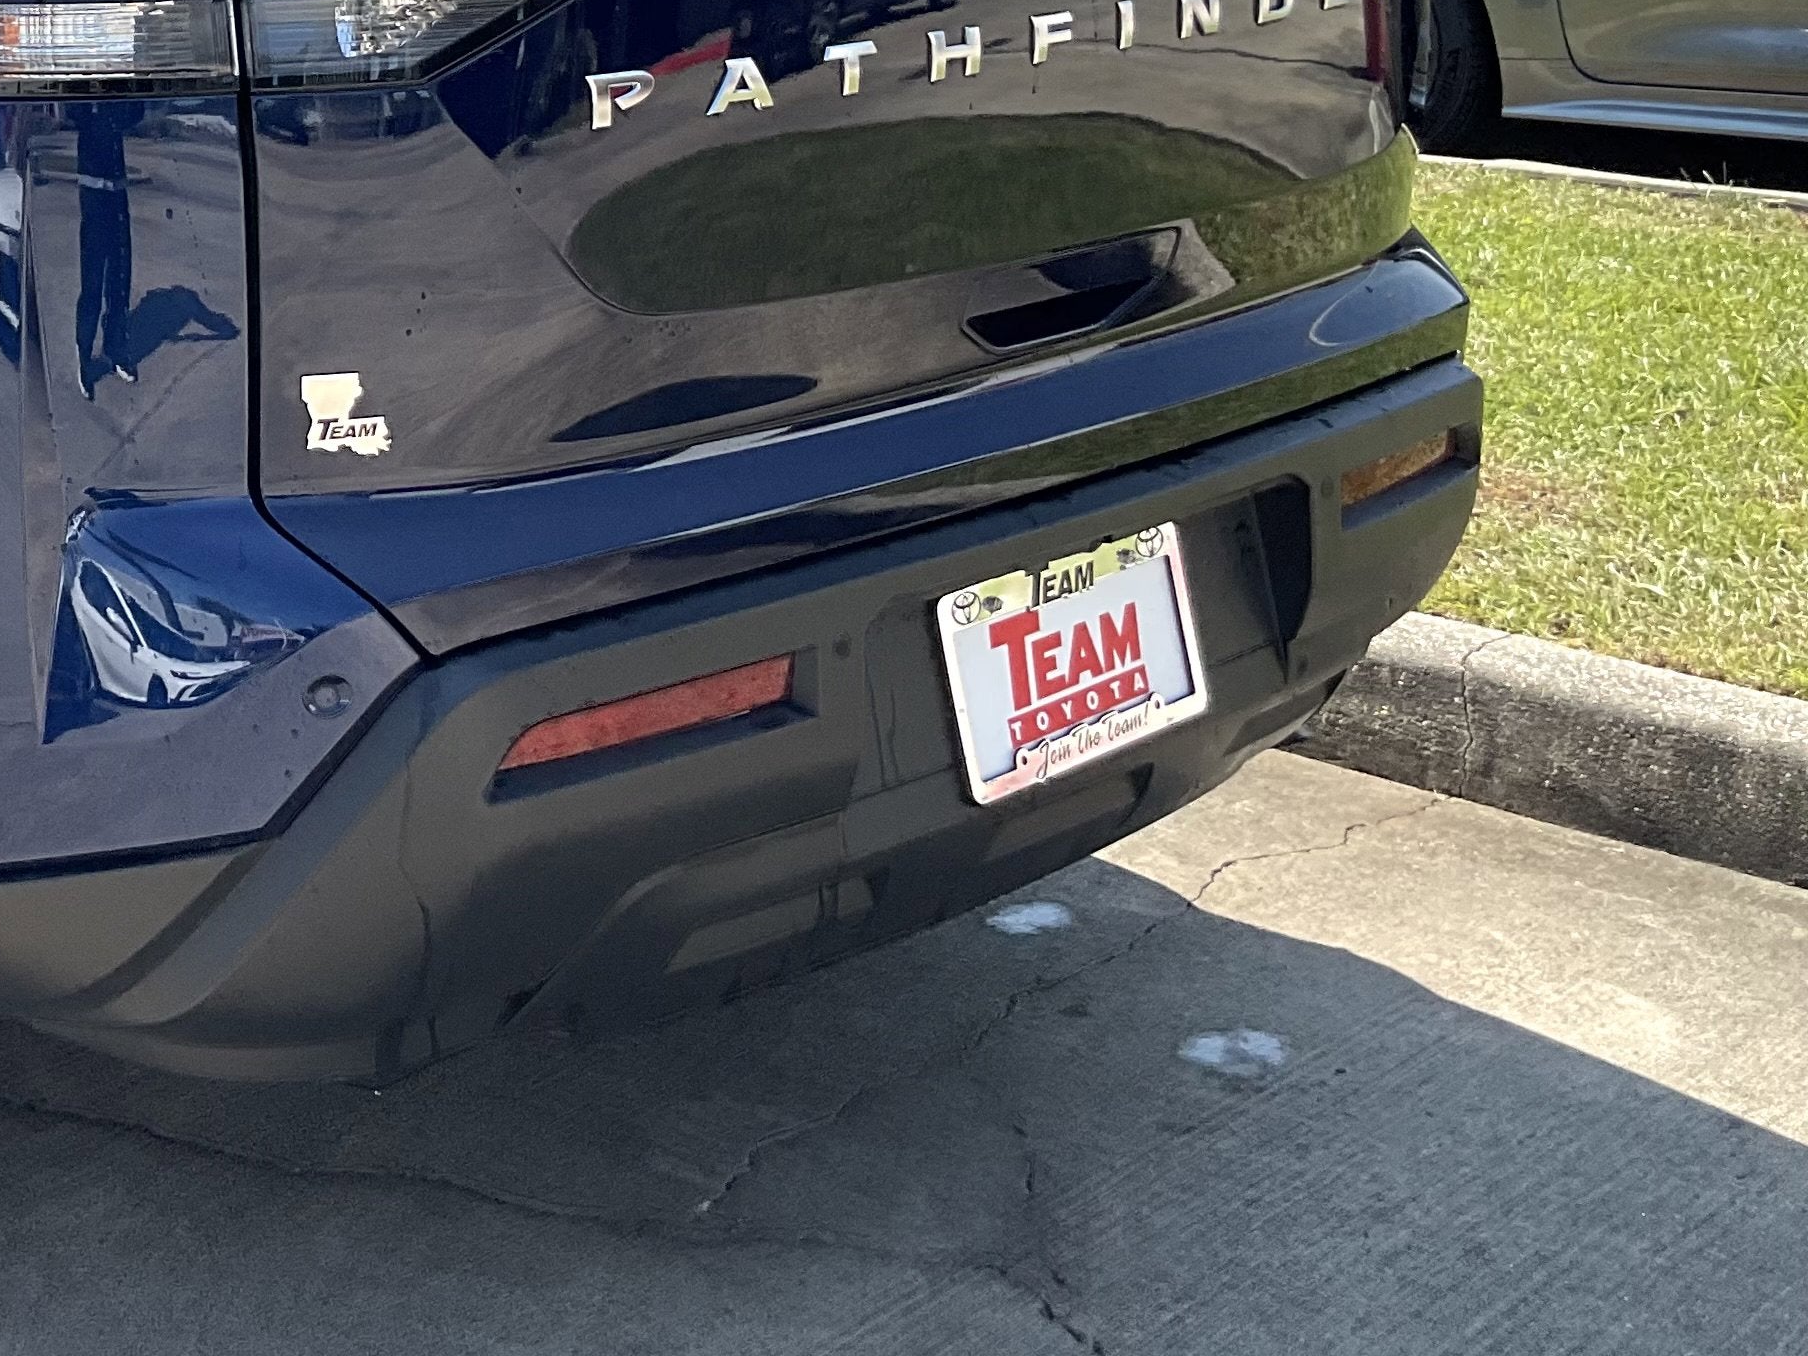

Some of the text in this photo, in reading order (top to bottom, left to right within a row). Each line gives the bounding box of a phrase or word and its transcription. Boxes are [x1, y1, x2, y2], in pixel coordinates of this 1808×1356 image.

[317, 418, 378, 441] TEAM
[989, 602, 1141, 712] TEAM
[1011, 671, 1146, 741] TOYOTA
[1036, 702, 1149, 779] Join The Team!
